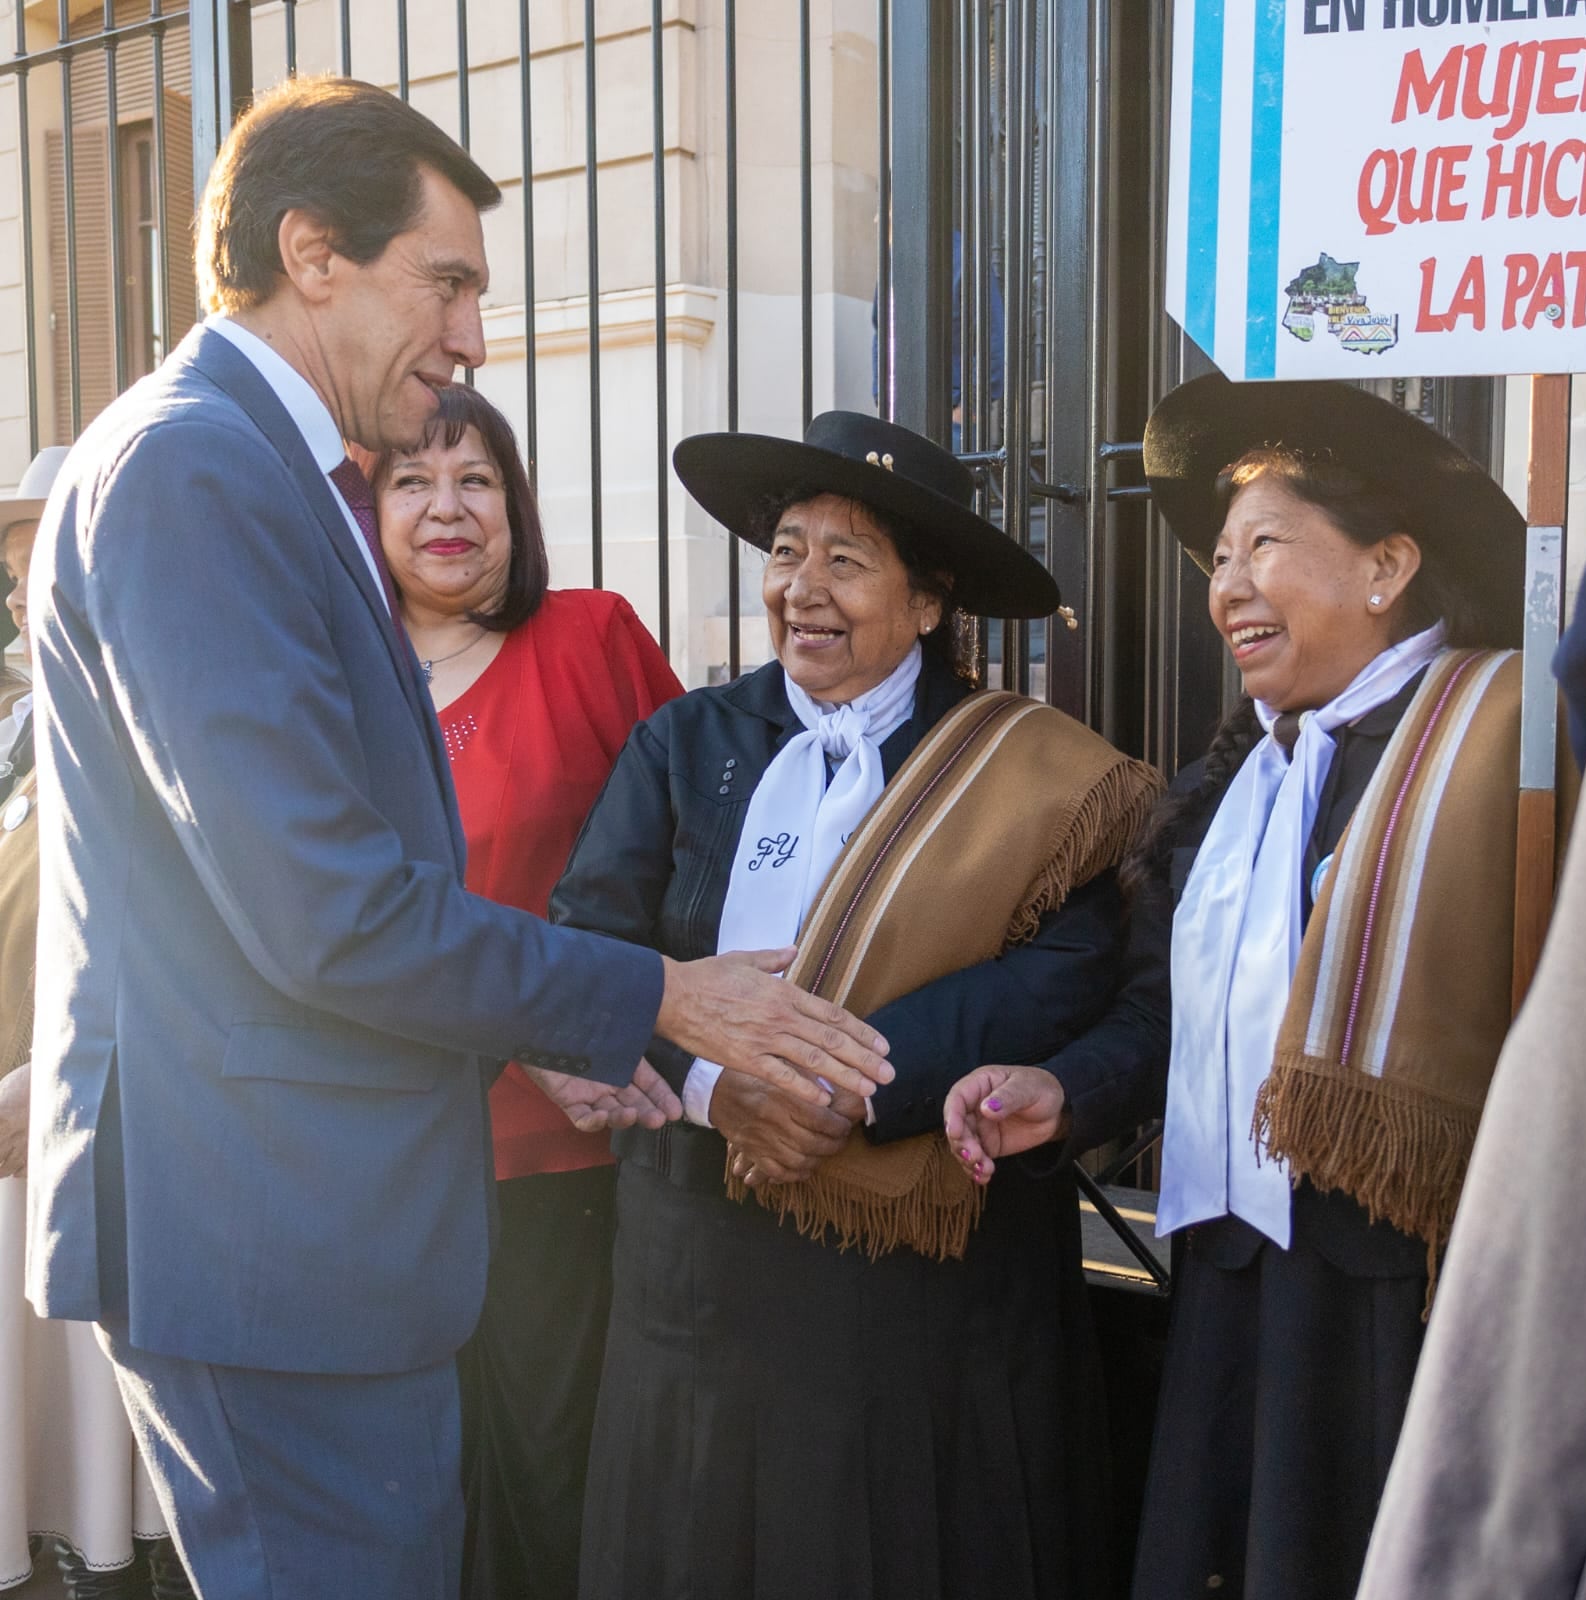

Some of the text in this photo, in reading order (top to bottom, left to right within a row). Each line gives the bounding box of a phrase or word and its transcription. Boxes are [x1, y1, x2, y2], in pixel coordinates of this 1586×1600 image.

[1358, 145, 1472, 235] QUE
[1415, 253, 1485, 333] LA
[749, 832, 799, 871] FY
